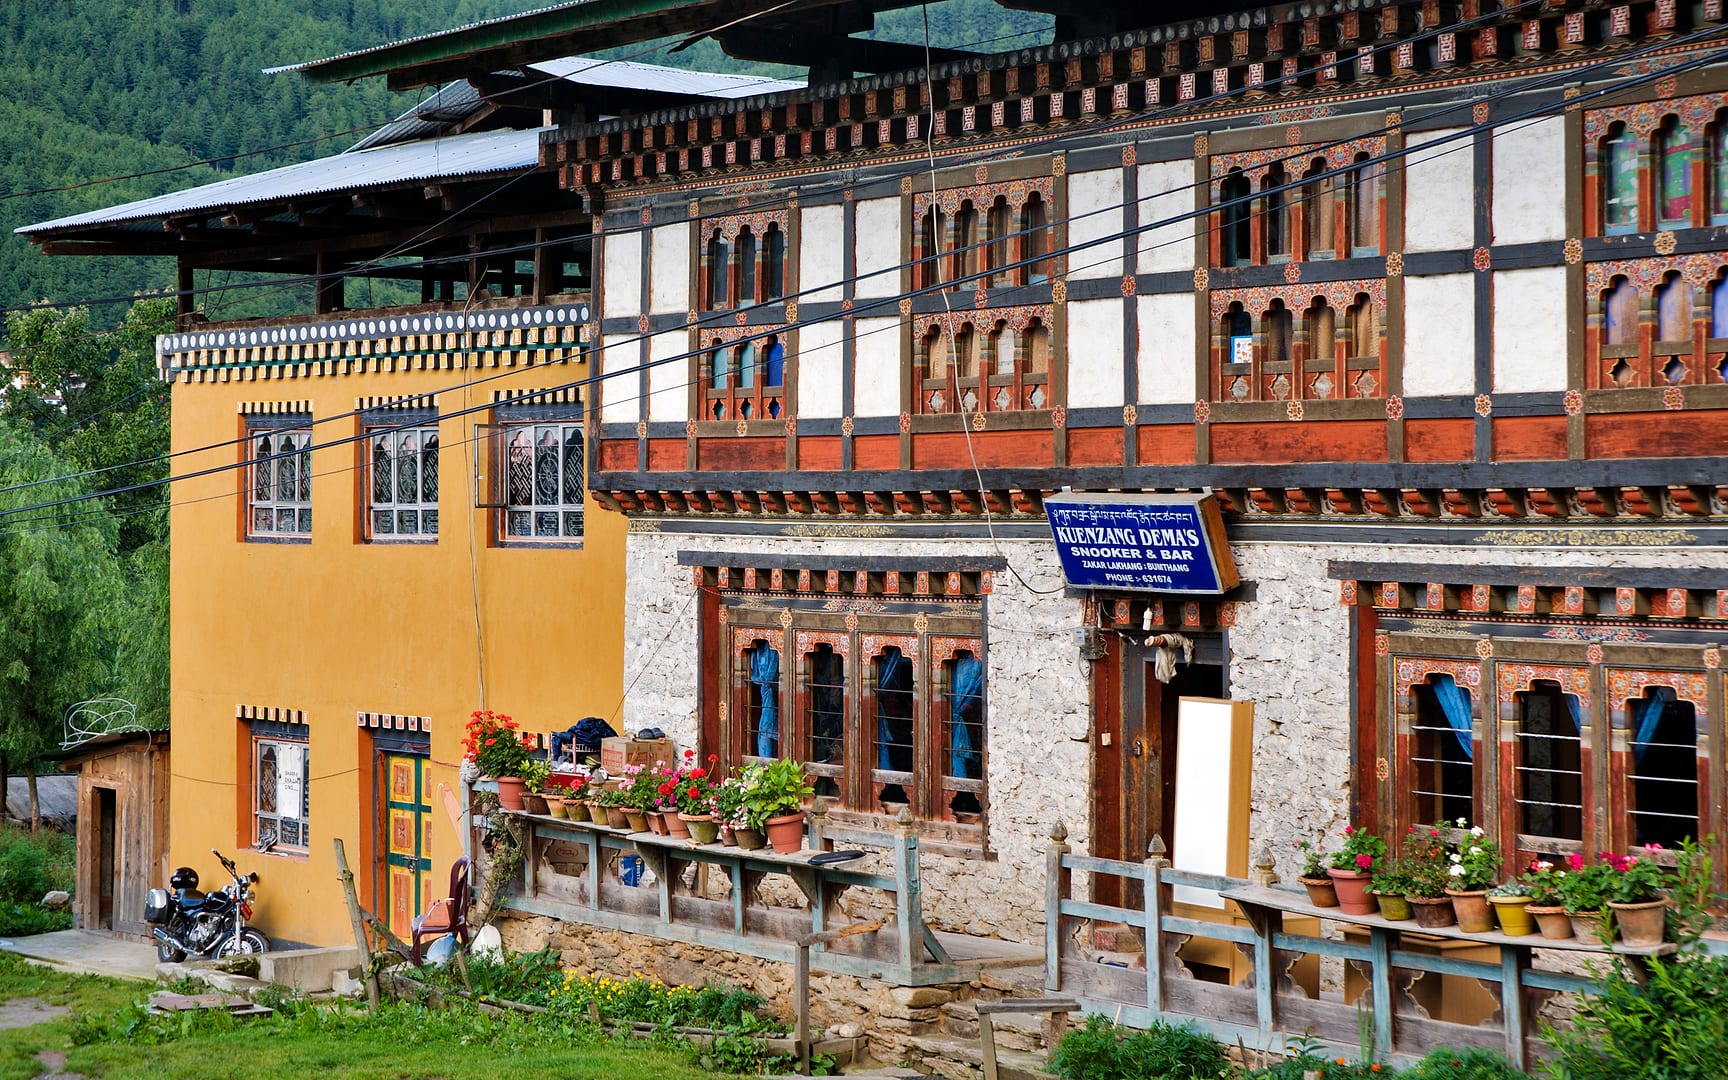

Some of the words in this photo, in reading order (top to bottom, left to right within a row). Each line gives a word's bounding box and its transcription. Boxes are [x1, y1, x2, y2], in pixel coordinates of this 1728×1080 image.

[1056, 526, 1137, 546] KUENZANG
[1140, 529, 1200, 547] DEMA'S
[1071, 547, 1142, 559] SNOOKER
[1146, 549, 1157, 559] &
[1161, 549, 1194, 560] BAR
[1082, 560, 1107, 569] ZAKAR
[1107, 561, 1143, 571] LAKHANG
[1105, 573, 1135, 582] PHONE
[1142, 574, 1173, 584] 631674
